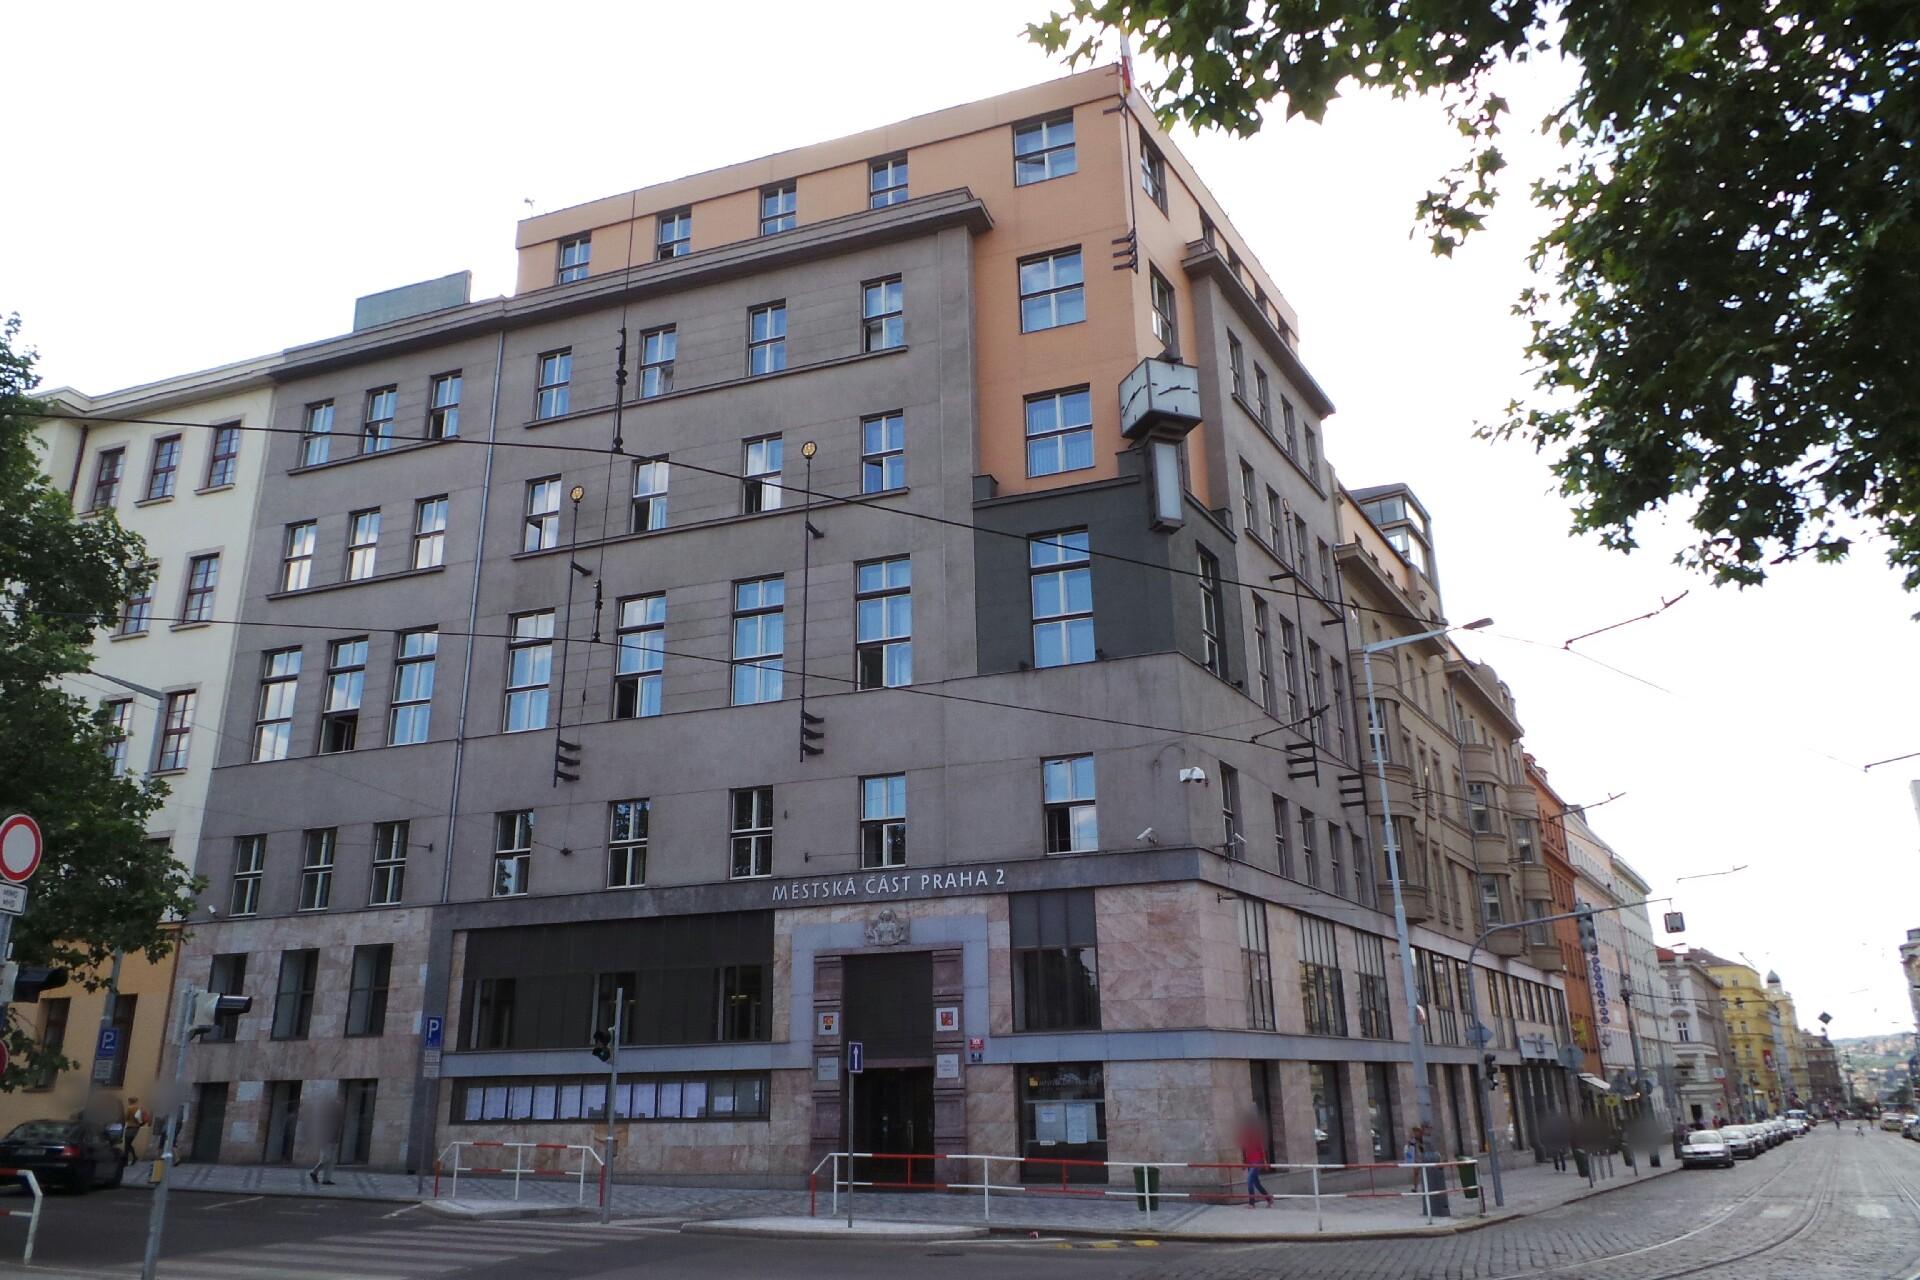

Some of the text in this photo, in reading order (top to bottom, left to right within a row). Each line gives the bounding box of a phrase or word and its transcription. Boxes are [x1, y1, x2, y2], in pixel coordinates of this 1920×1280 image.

[772, 868, 1005, 900] MĚSTSKÁ ČÁST PRAHA 2
[428, 1019, 439, 1038] P
